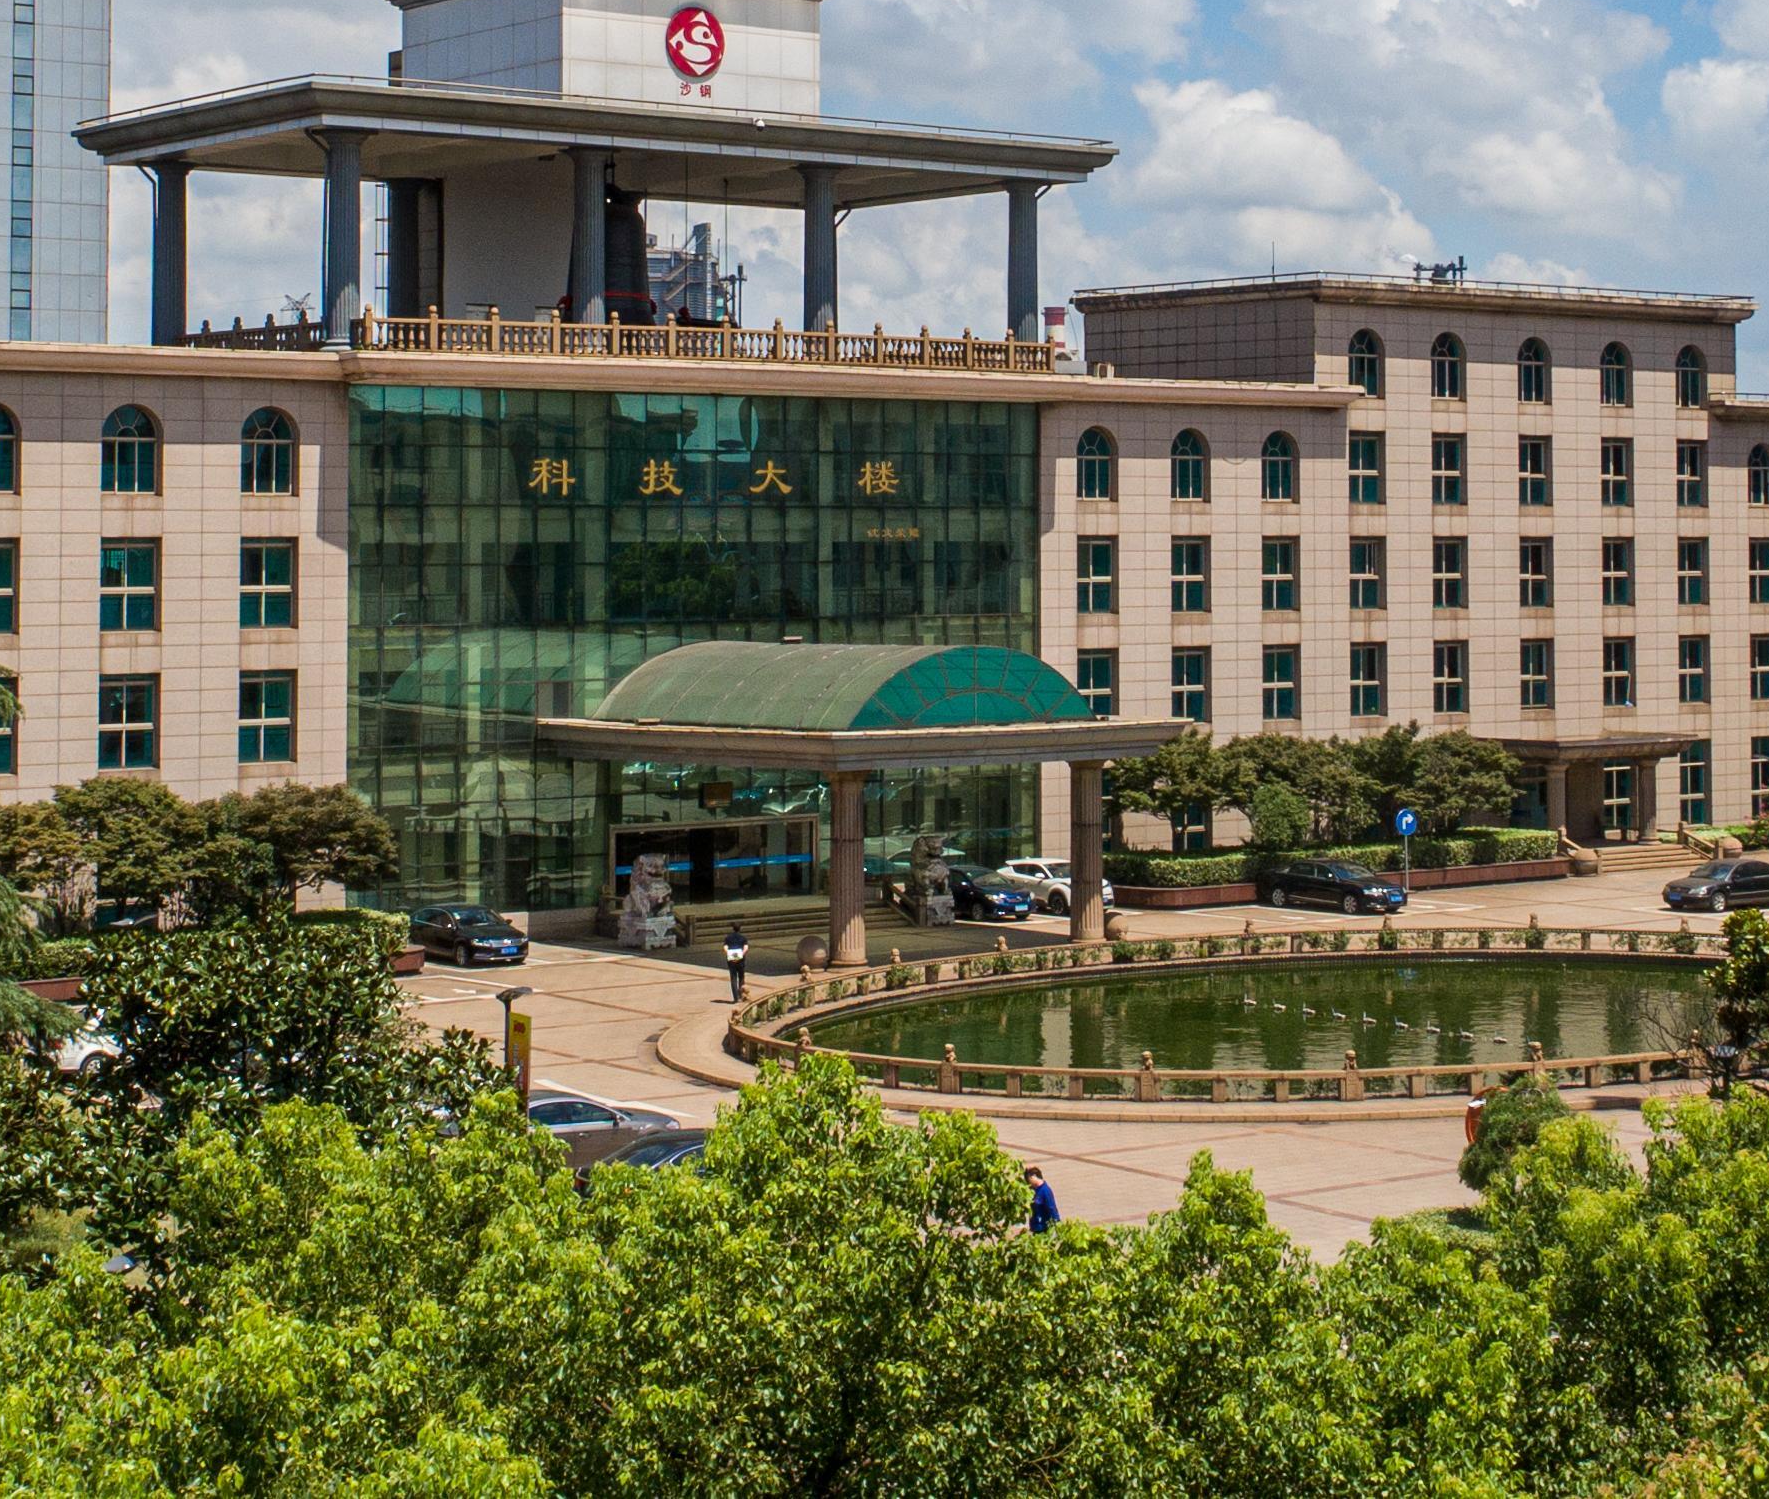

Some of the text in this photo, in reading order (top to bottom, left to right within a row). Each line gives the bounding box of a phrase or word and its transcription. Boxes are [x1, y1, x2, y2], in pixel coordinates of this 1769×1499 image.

[680, 81, 712, 98] 沙钢
[529, 457, 900, 496] 科技大楼
